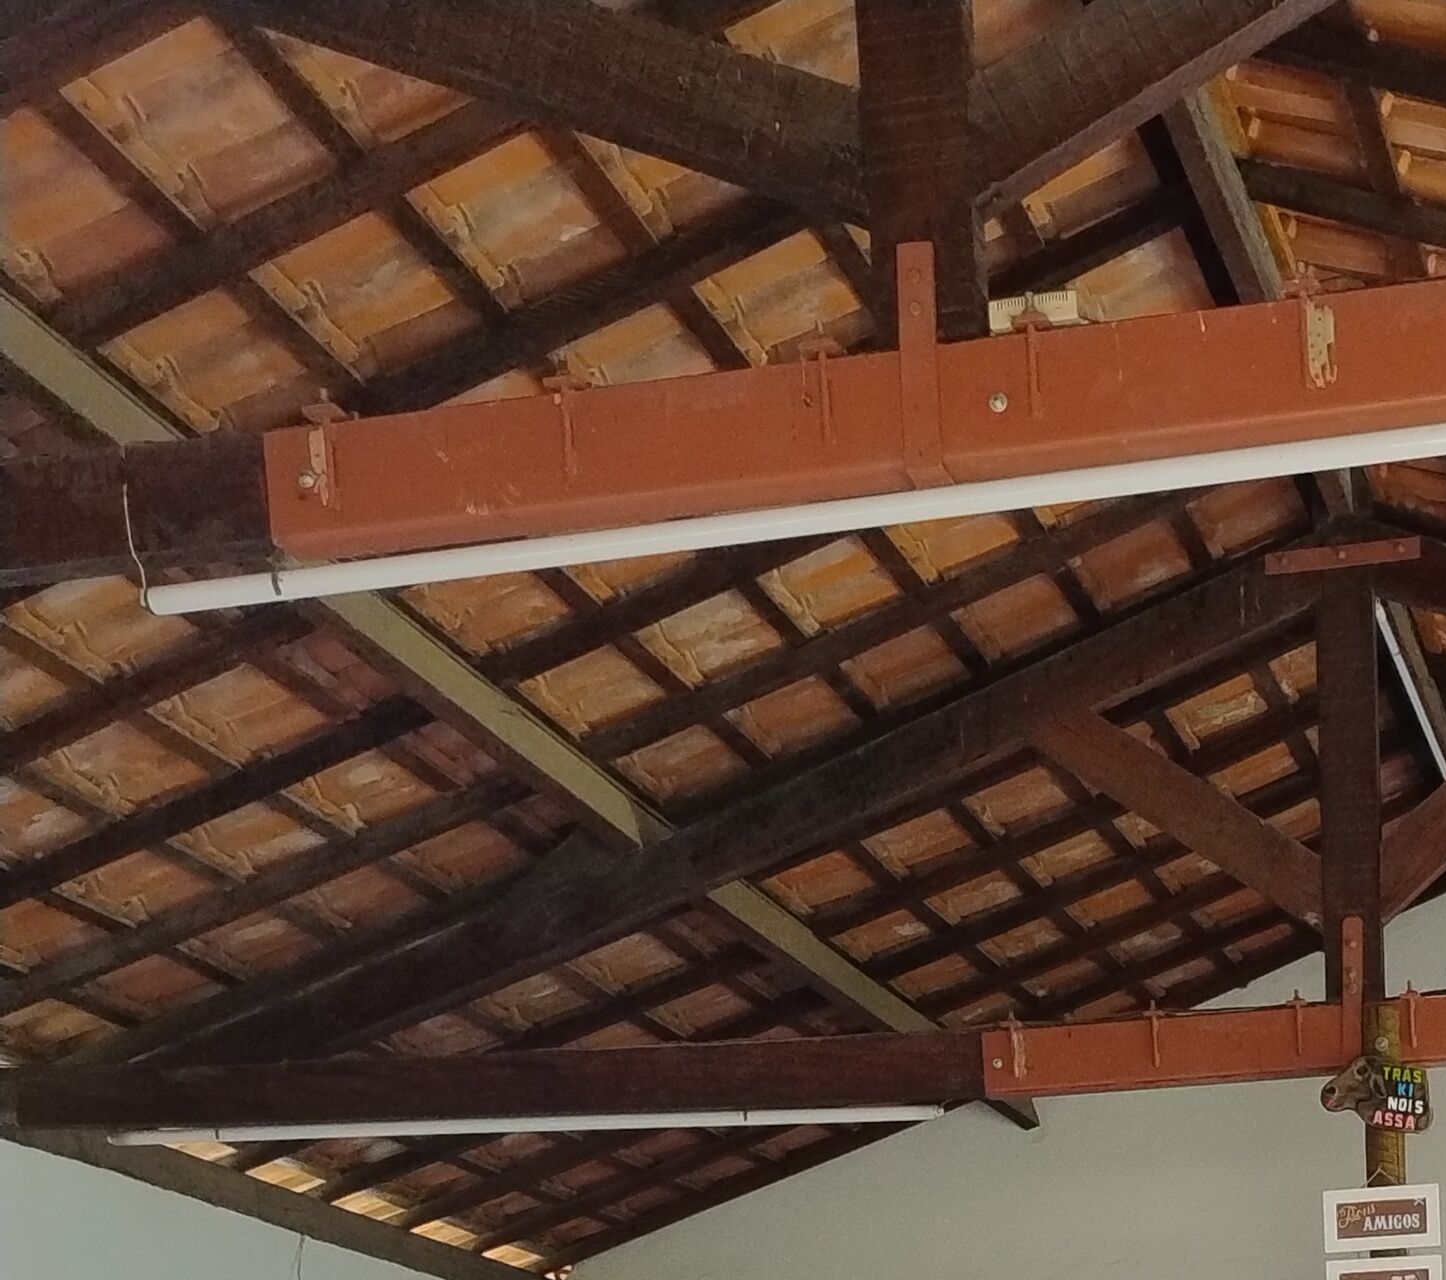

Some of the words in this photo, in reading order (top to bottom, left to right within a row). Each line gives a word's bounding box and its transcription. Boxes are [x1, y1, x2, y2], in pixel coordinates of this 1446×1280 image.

[1397, 1082, 1414, 1097] KI
[1387, 1096, 1424, 1114] NOIS
[1372, 1110, 1415, 1130] ASSA
[1362, 1213, 1420, 1232] AMIGOS
